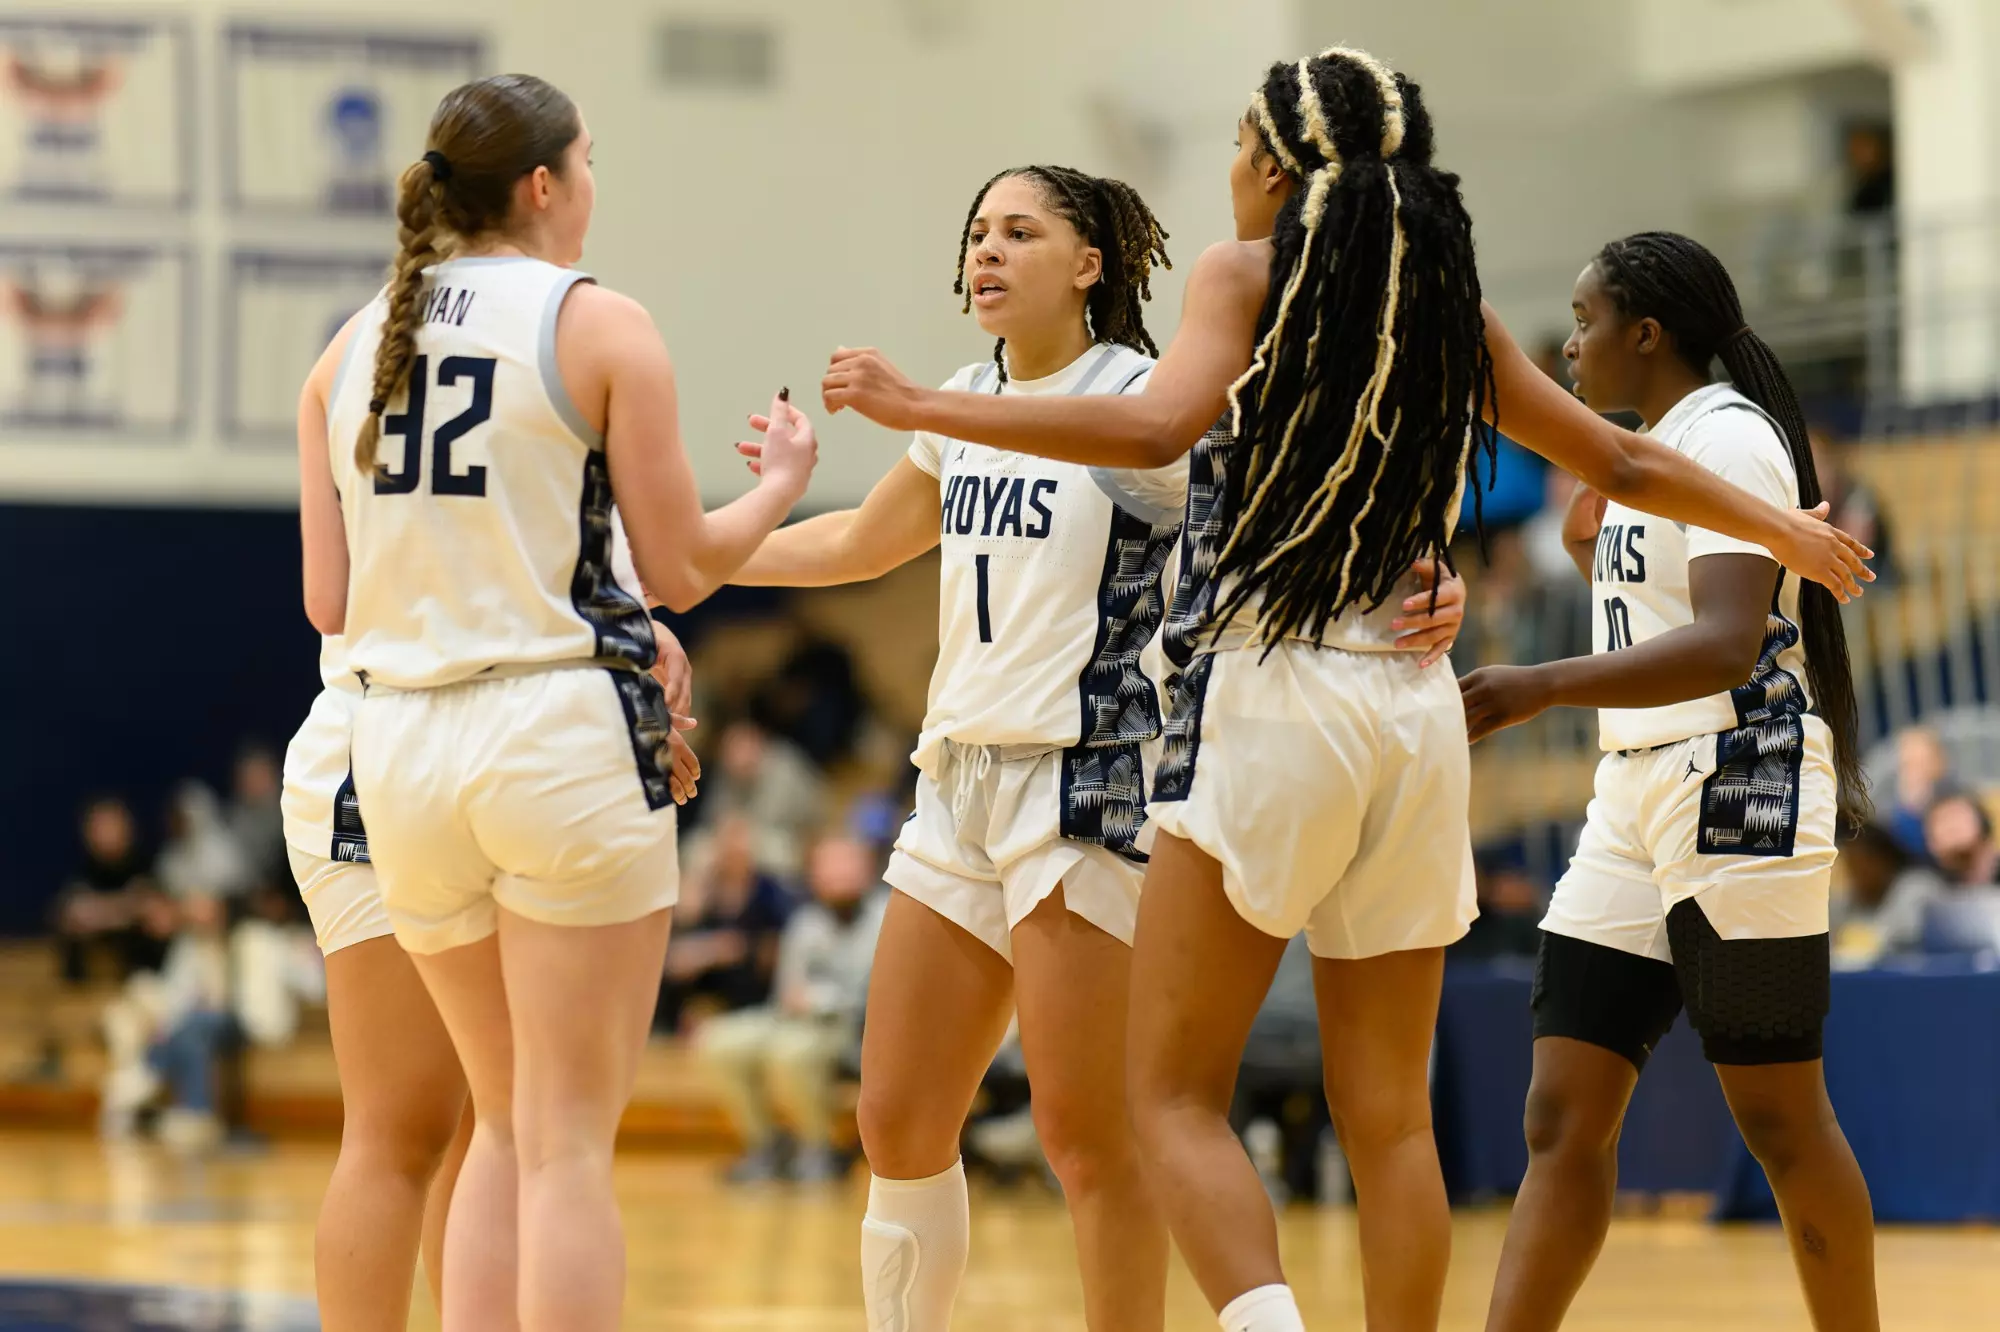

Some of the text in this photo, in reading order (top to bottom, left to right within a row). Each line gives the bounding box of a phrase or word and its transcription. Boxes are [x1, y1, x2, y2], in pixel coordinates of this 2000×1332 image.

[374, 354, 497, 497] 32
[941, 475, 1058, 539] HOYAS
[975, 554, 993, 643] 1
